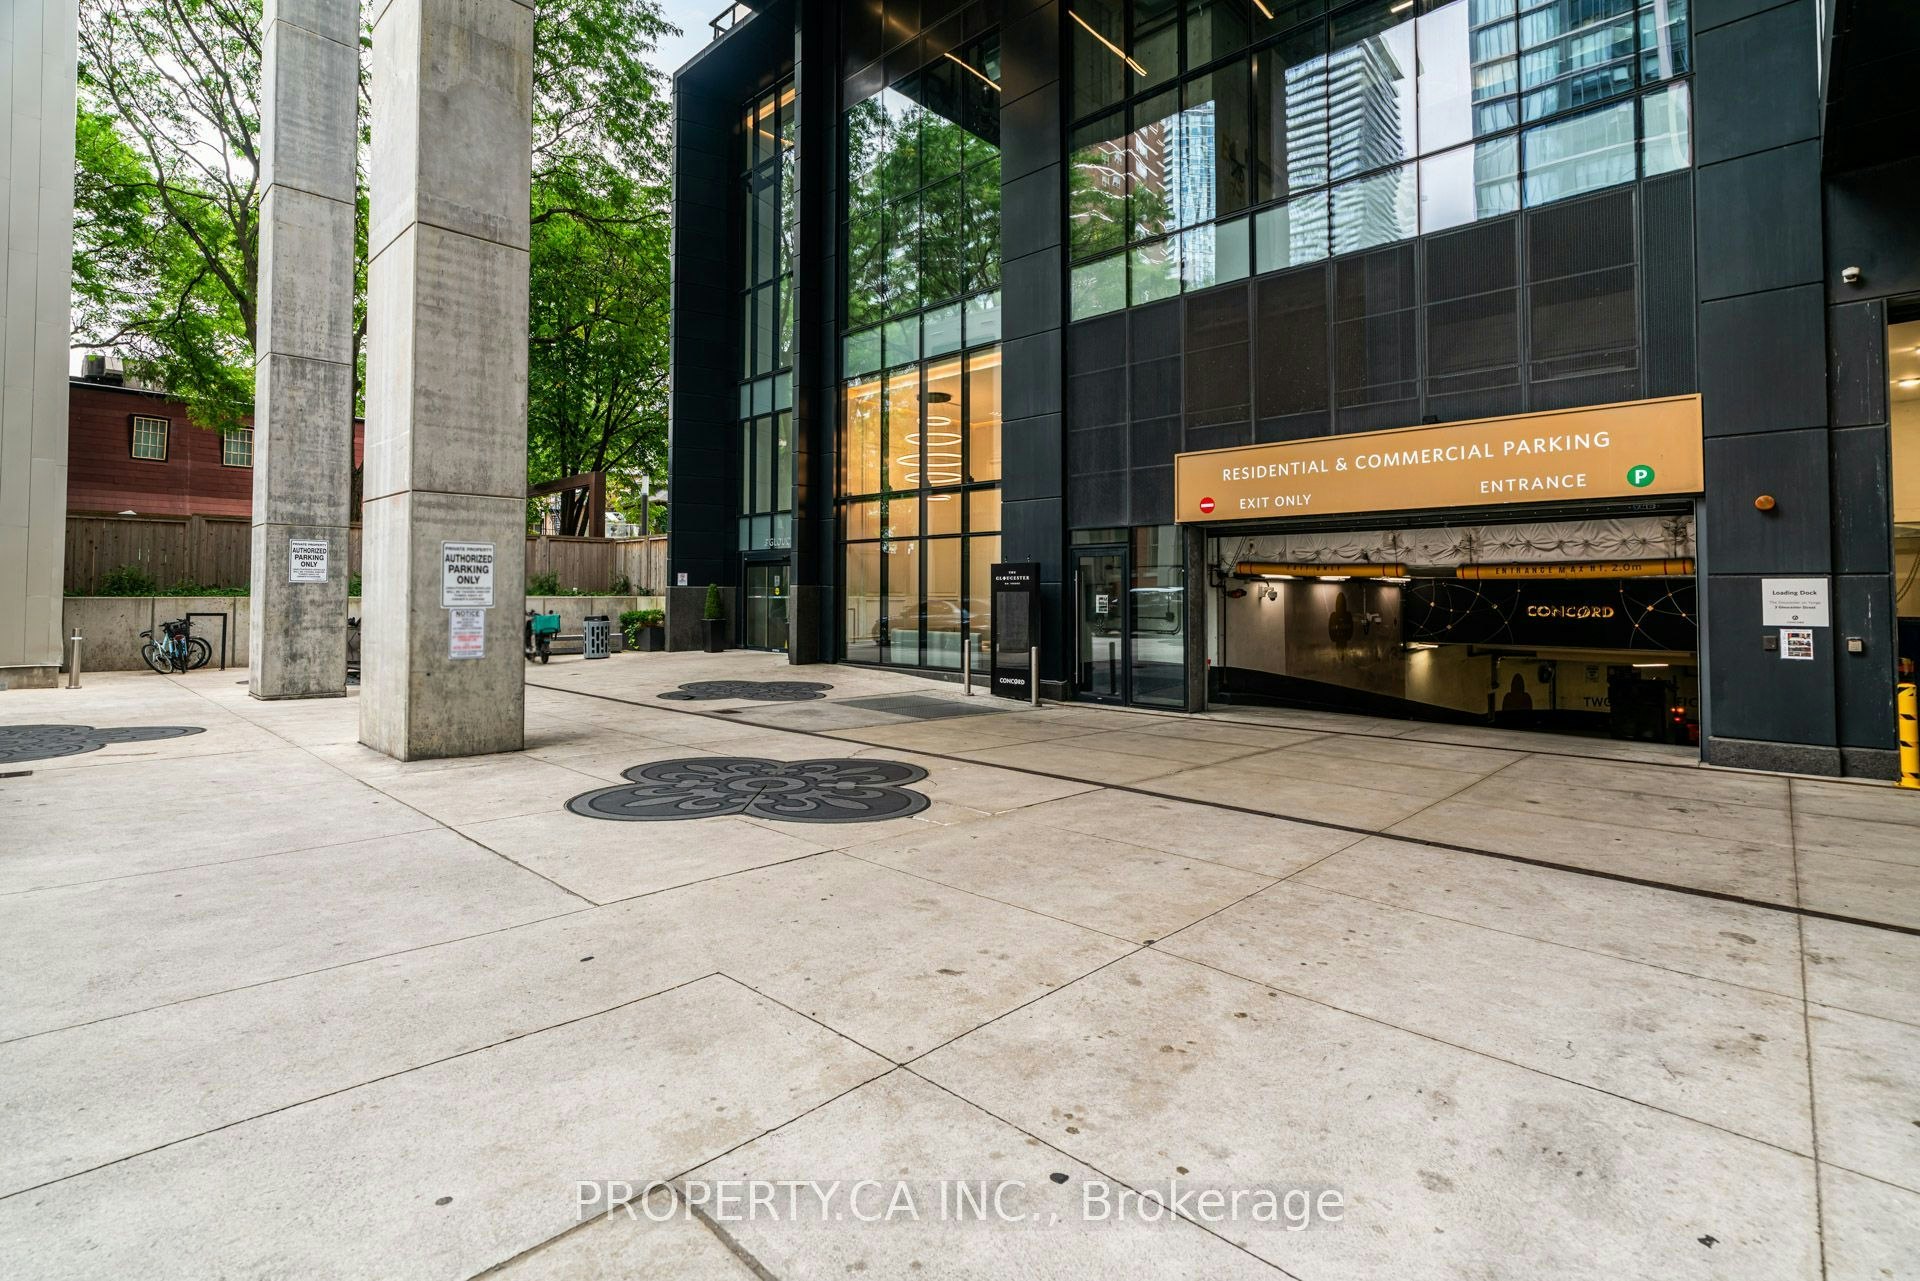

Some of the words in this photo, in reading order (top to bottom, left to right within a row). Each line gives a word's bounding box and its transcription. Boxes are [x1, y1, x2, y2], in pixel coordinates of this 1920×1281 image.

[1223, 459, 1328, 481] RESIDENTIAL
[1335, 457, 1348, 471] &
[1355, 443, 1494, 470] COMMERCIAL
[1503, 431, 1611, 456] PARKING
[1480, 473, 1587, 494] ENTRANCE
[1239, 496, 1270, 510] EXIT
[1274, 494, 1312, 507] ONLY
[445, 554, 493, 563] AUTHORIZED
[448, 565, 489, 574] PARKING
[1495, 566, 1553, 575] ENTRANCE
[1559, 566, 1584, 574] MAX
[1611, 562, 1642, 572] 2.0m
[456, 575, 480, 584] ONLY
